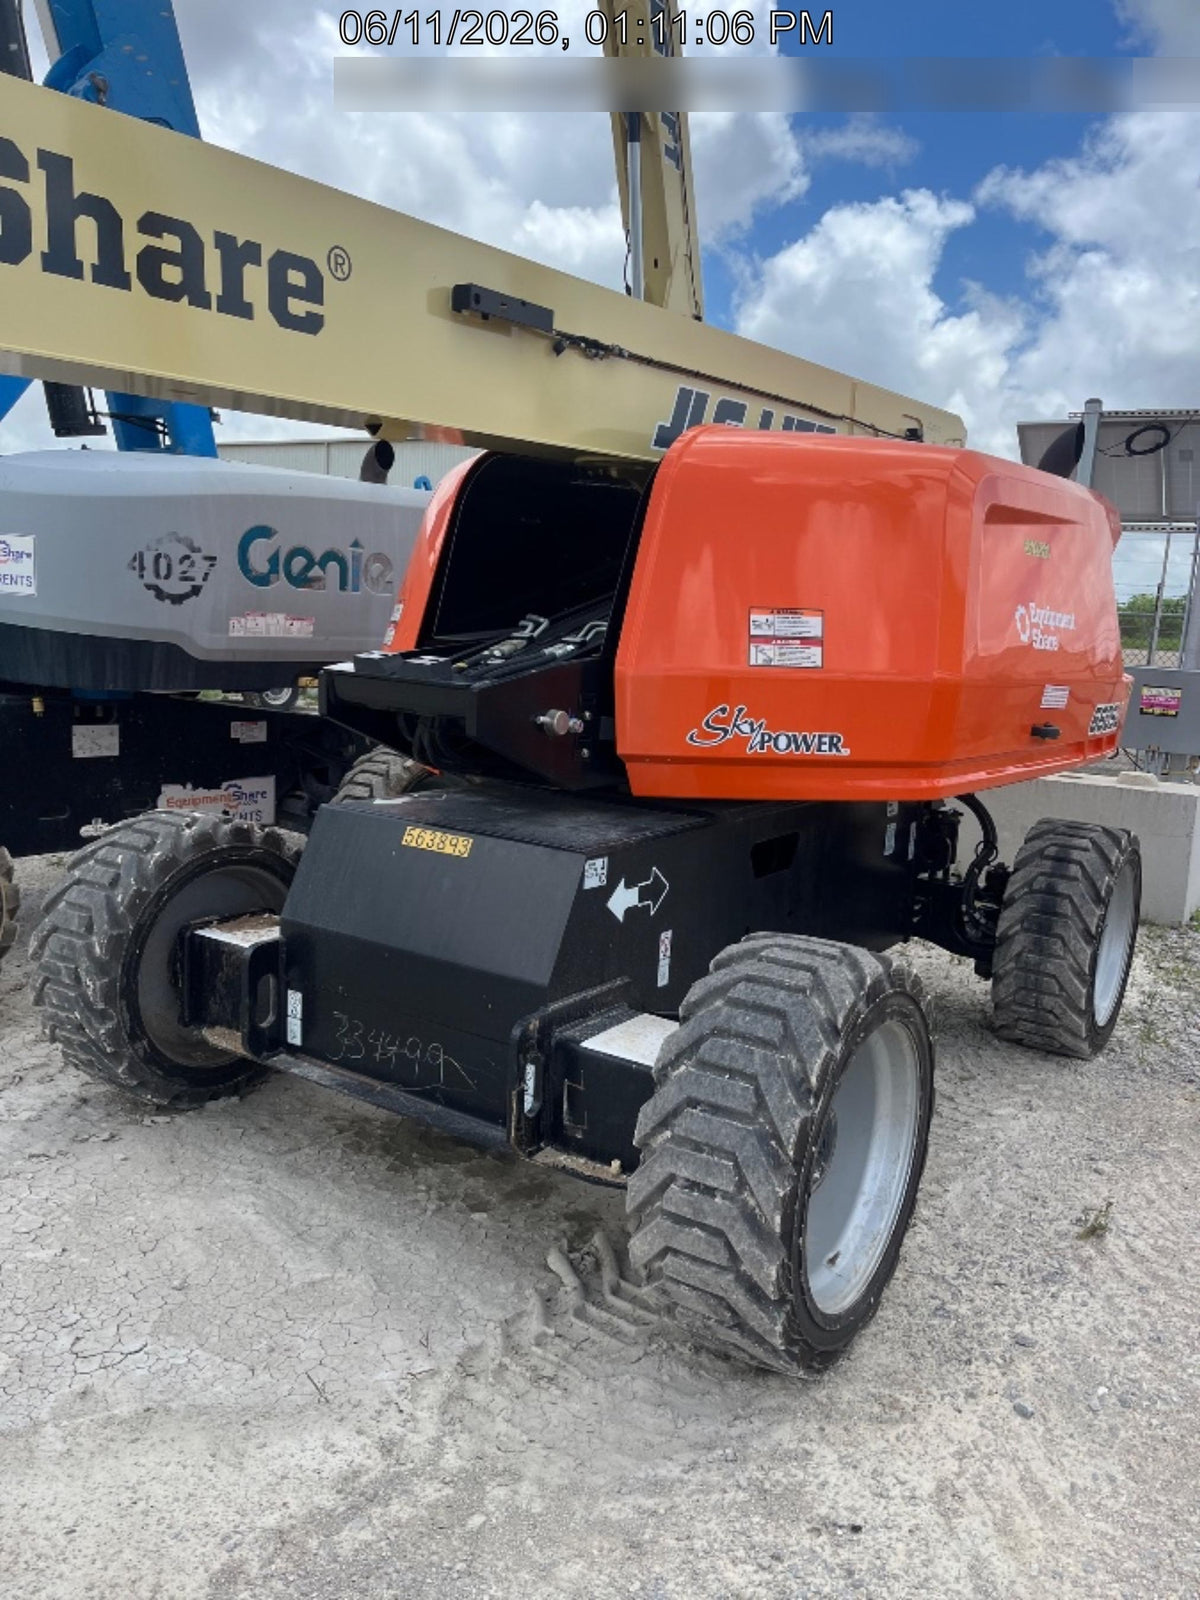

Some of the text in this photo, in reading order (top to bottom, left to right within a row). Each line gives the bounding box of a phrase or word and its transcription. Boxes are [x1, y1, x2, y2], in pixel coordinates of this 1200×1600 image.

[127, 551, 218, 582] 4027
[237, 524, 394, 596] Genie
[404, 827, 470, 856] 563893
